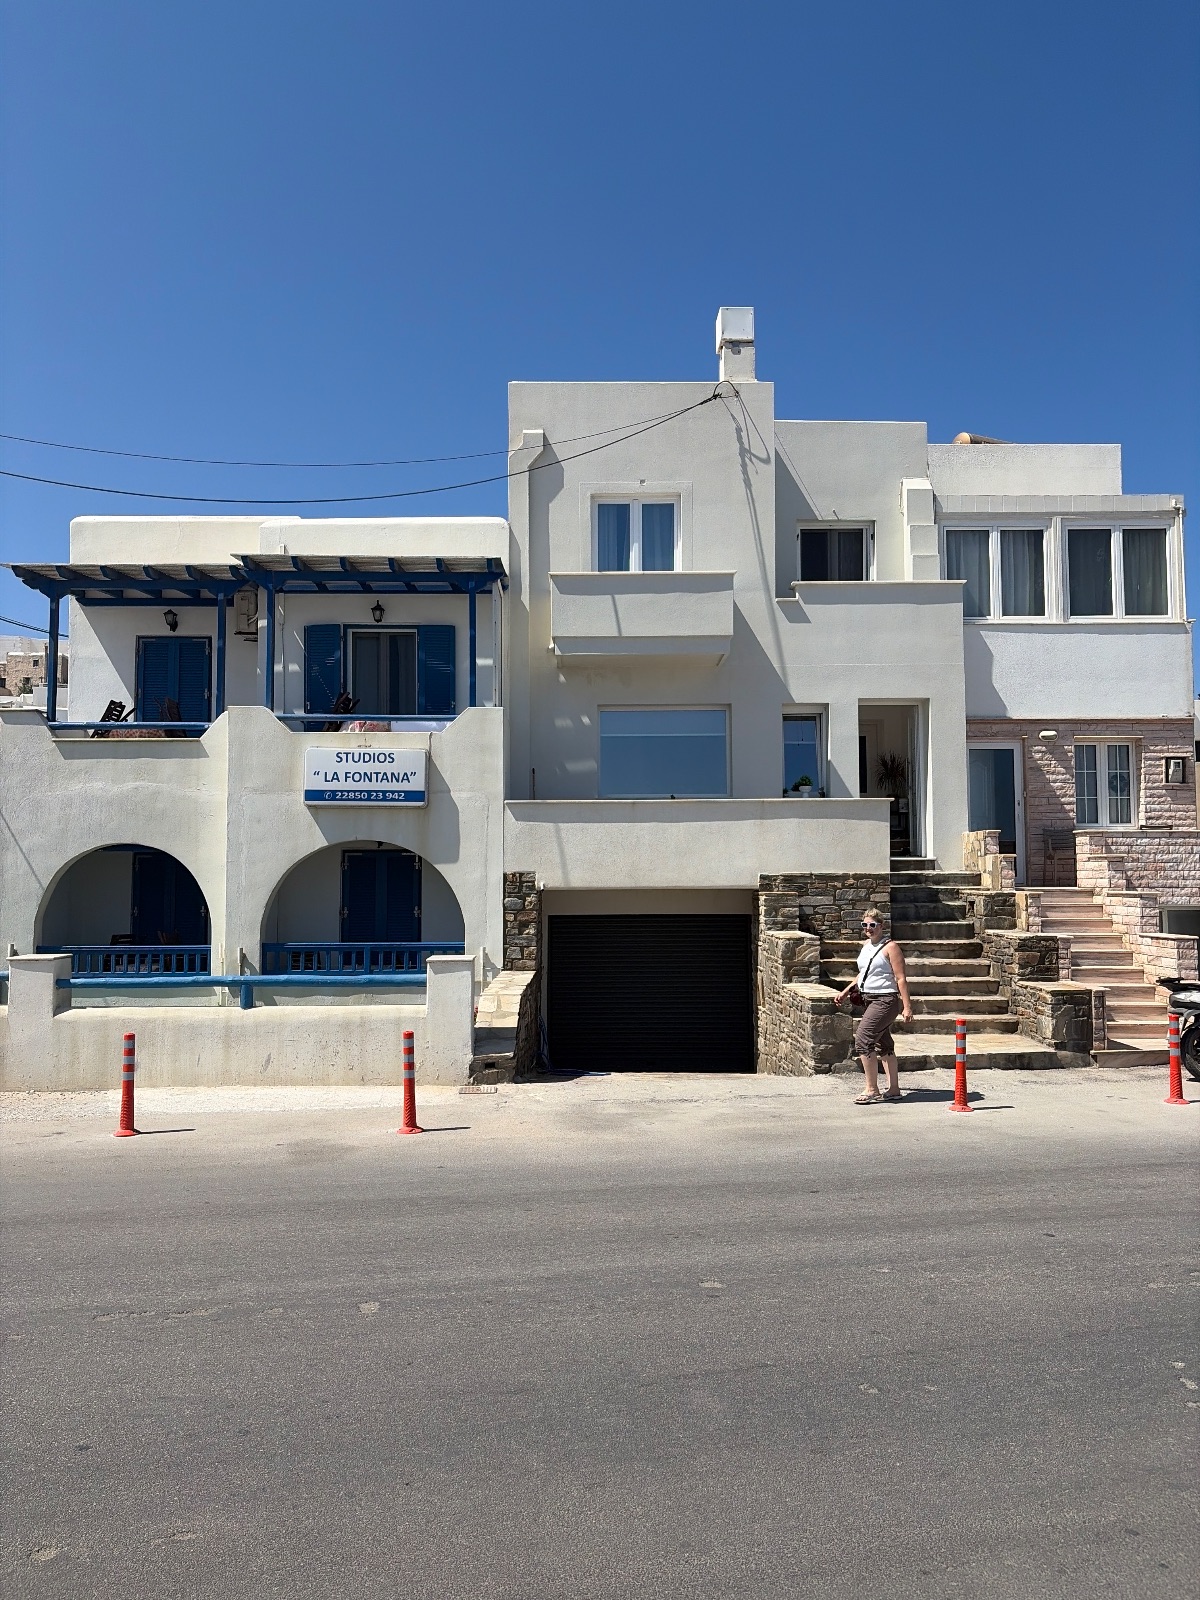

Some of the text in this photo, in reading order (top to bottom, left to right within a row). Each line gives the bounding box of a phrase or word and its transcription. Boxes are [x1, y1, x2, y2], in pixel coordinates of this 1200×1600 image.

[335, 752, 395, 764] STUDIOS
[344, 772, 417, 784] FONTANA”
[335, 792, 405, 800] 22850 23 942
